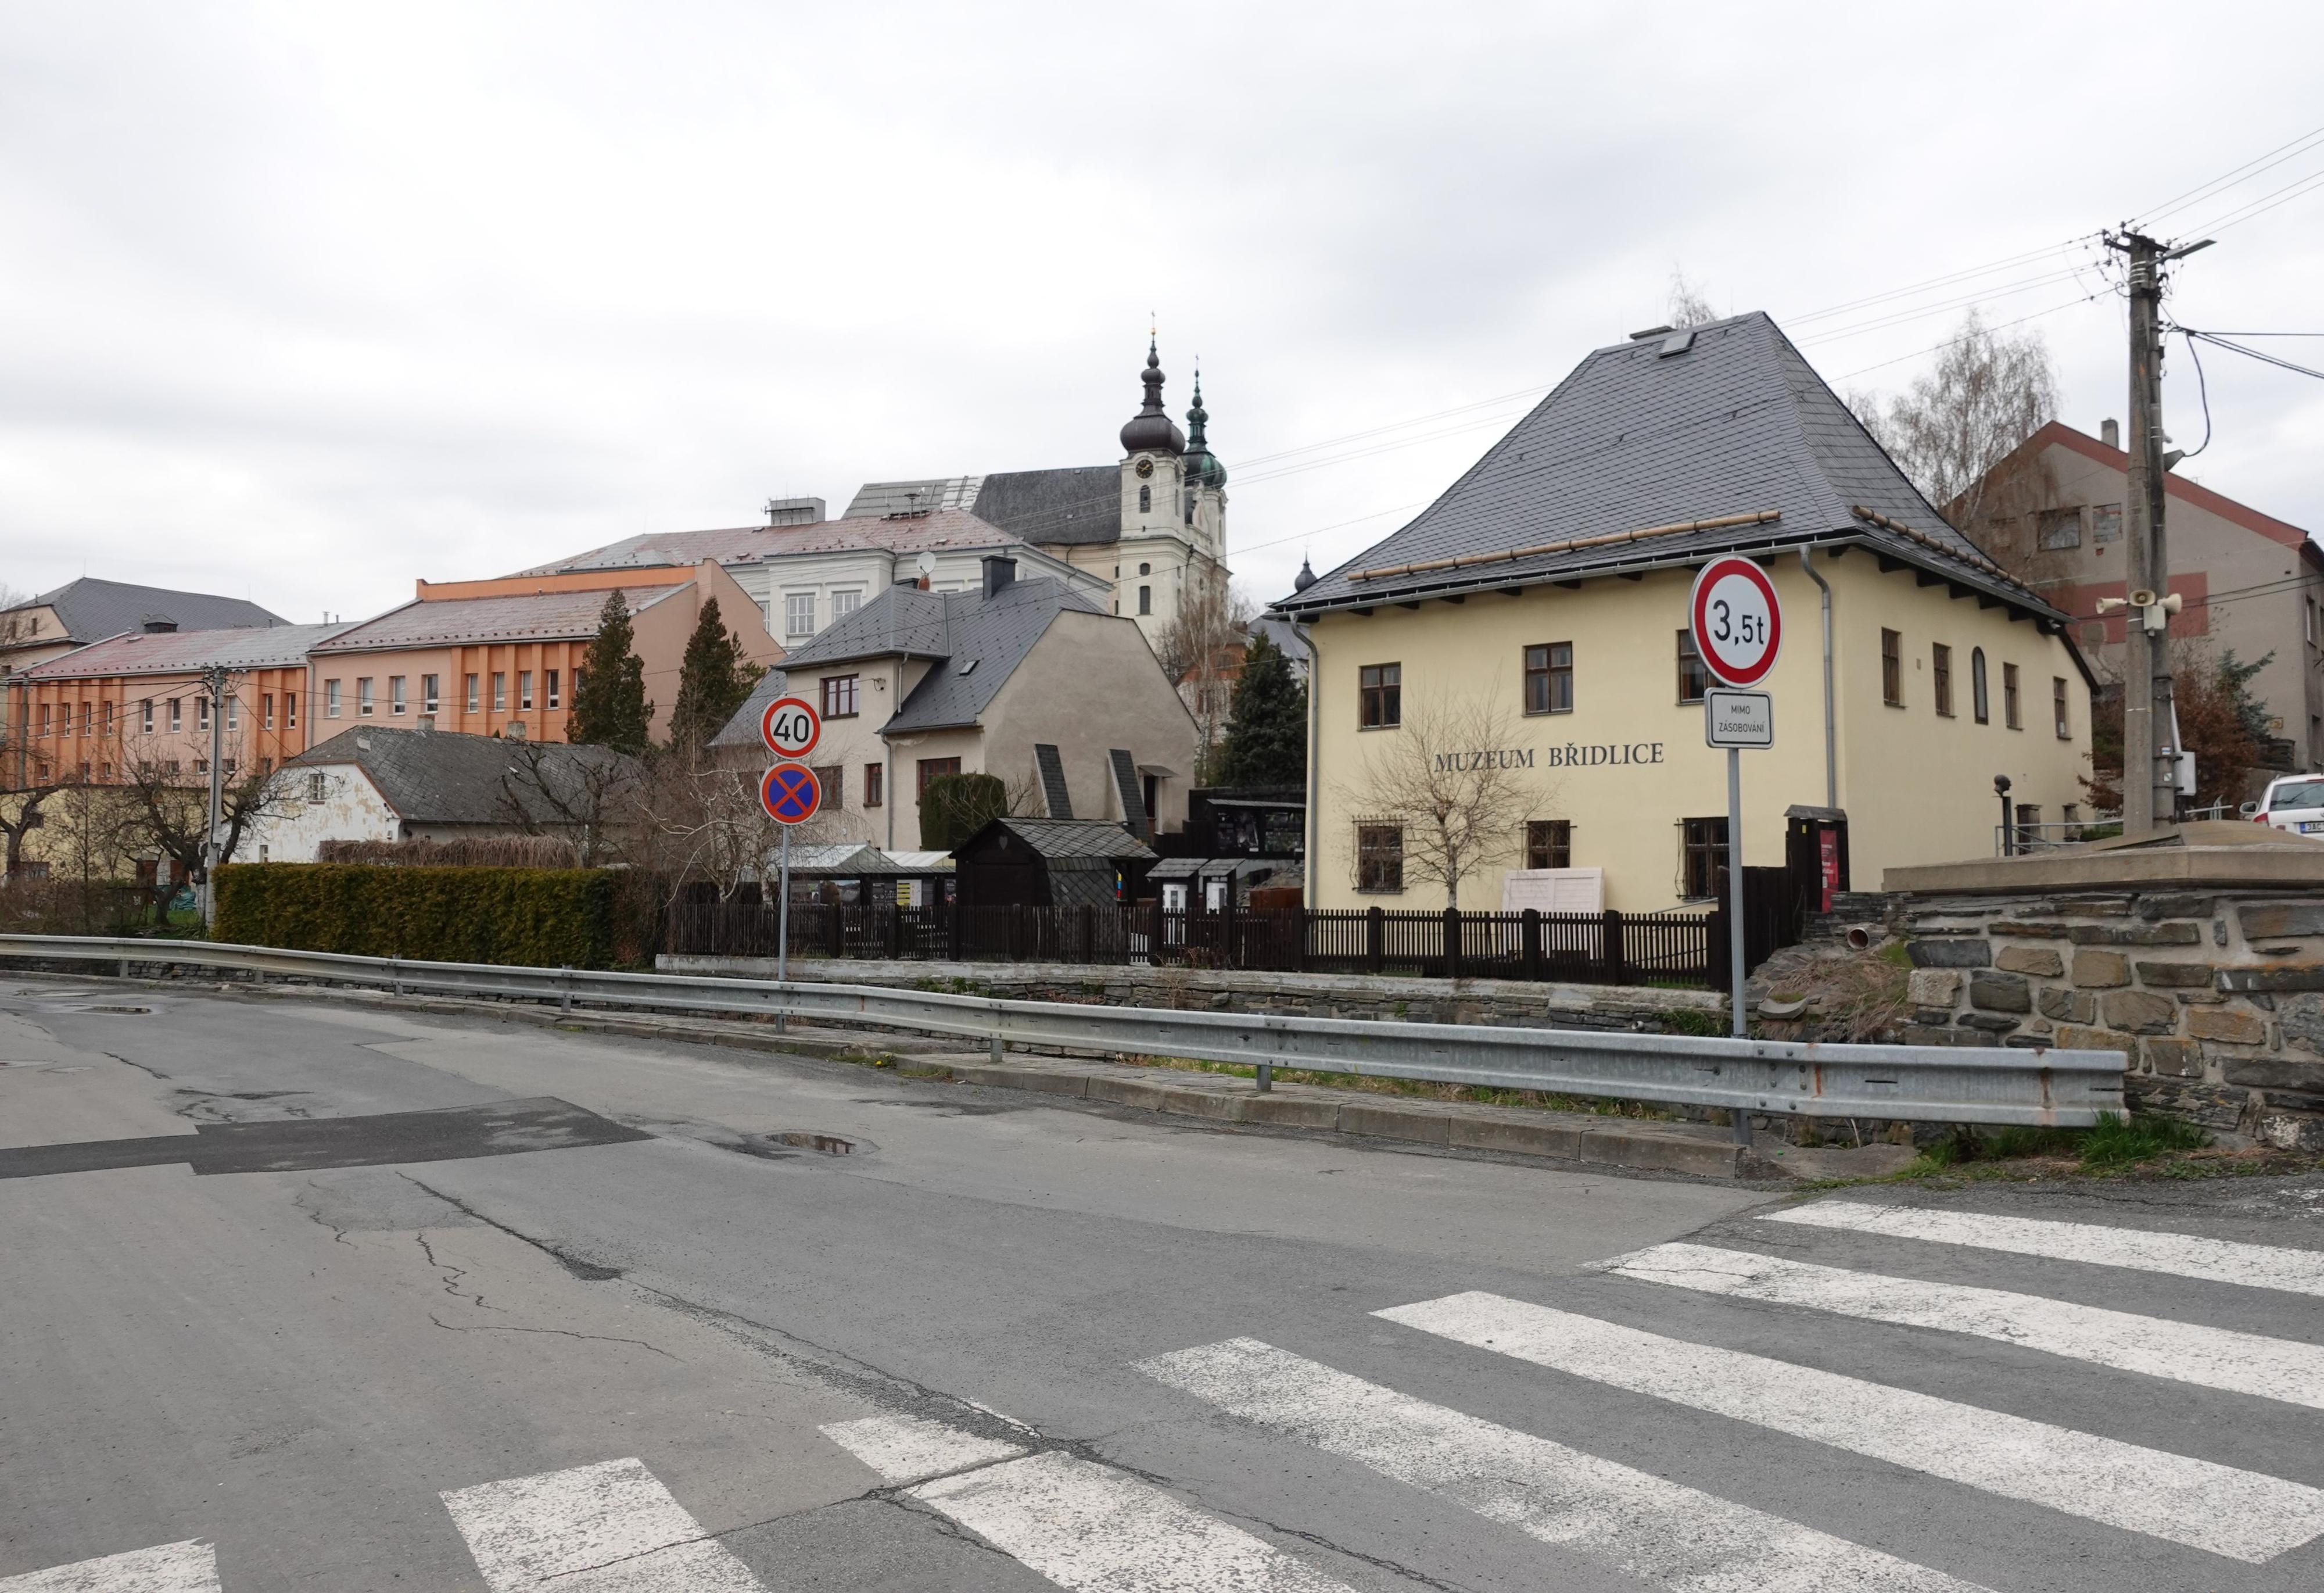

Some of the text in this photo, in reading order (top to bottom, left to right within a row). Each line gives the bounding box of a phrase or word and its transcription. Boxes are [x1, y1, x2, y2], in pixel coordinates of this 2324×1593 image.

[1713, 599, 1763, 646] 3,5t
[1731, 705, 1751, 715] MIMO
[773, 713, 809, 743] 40
[1719, 720, 1764, 733] ZÁSOBOVÁNÍ
[1434, 742, 1665, 772] MUZEUM BŘIDLICE
